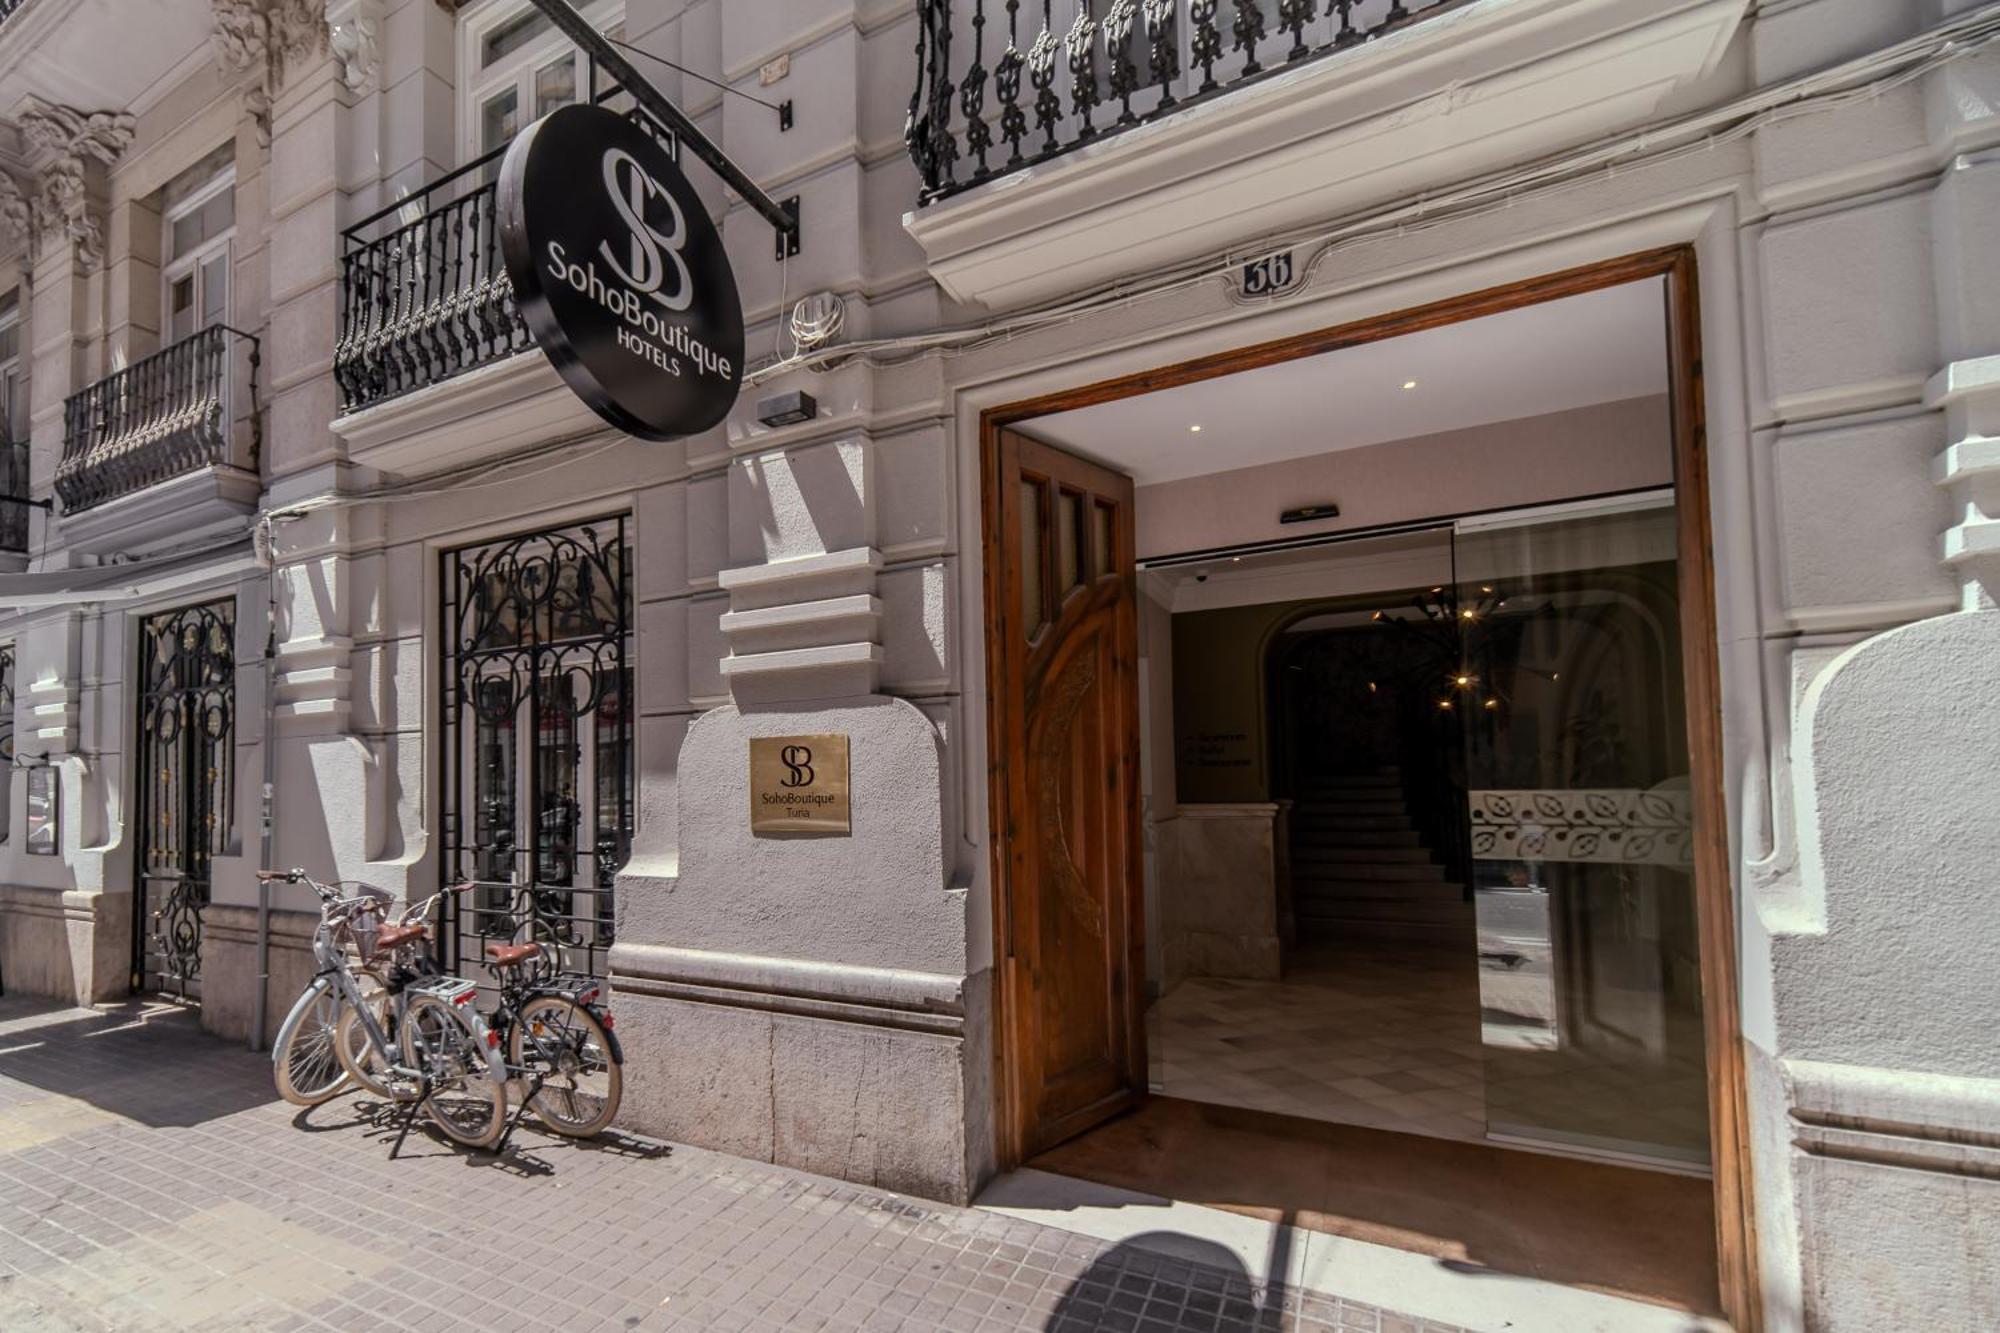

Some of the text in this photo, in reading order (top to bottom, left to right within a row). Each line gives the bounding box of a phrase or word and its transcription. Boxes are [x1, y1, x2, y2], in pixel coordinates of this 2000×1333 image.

[547, 241, 732, 380] SohoBoutique
[617, 325, 681, 377] HOTELS
[762, 791, 835, 807] SohoBoutique
